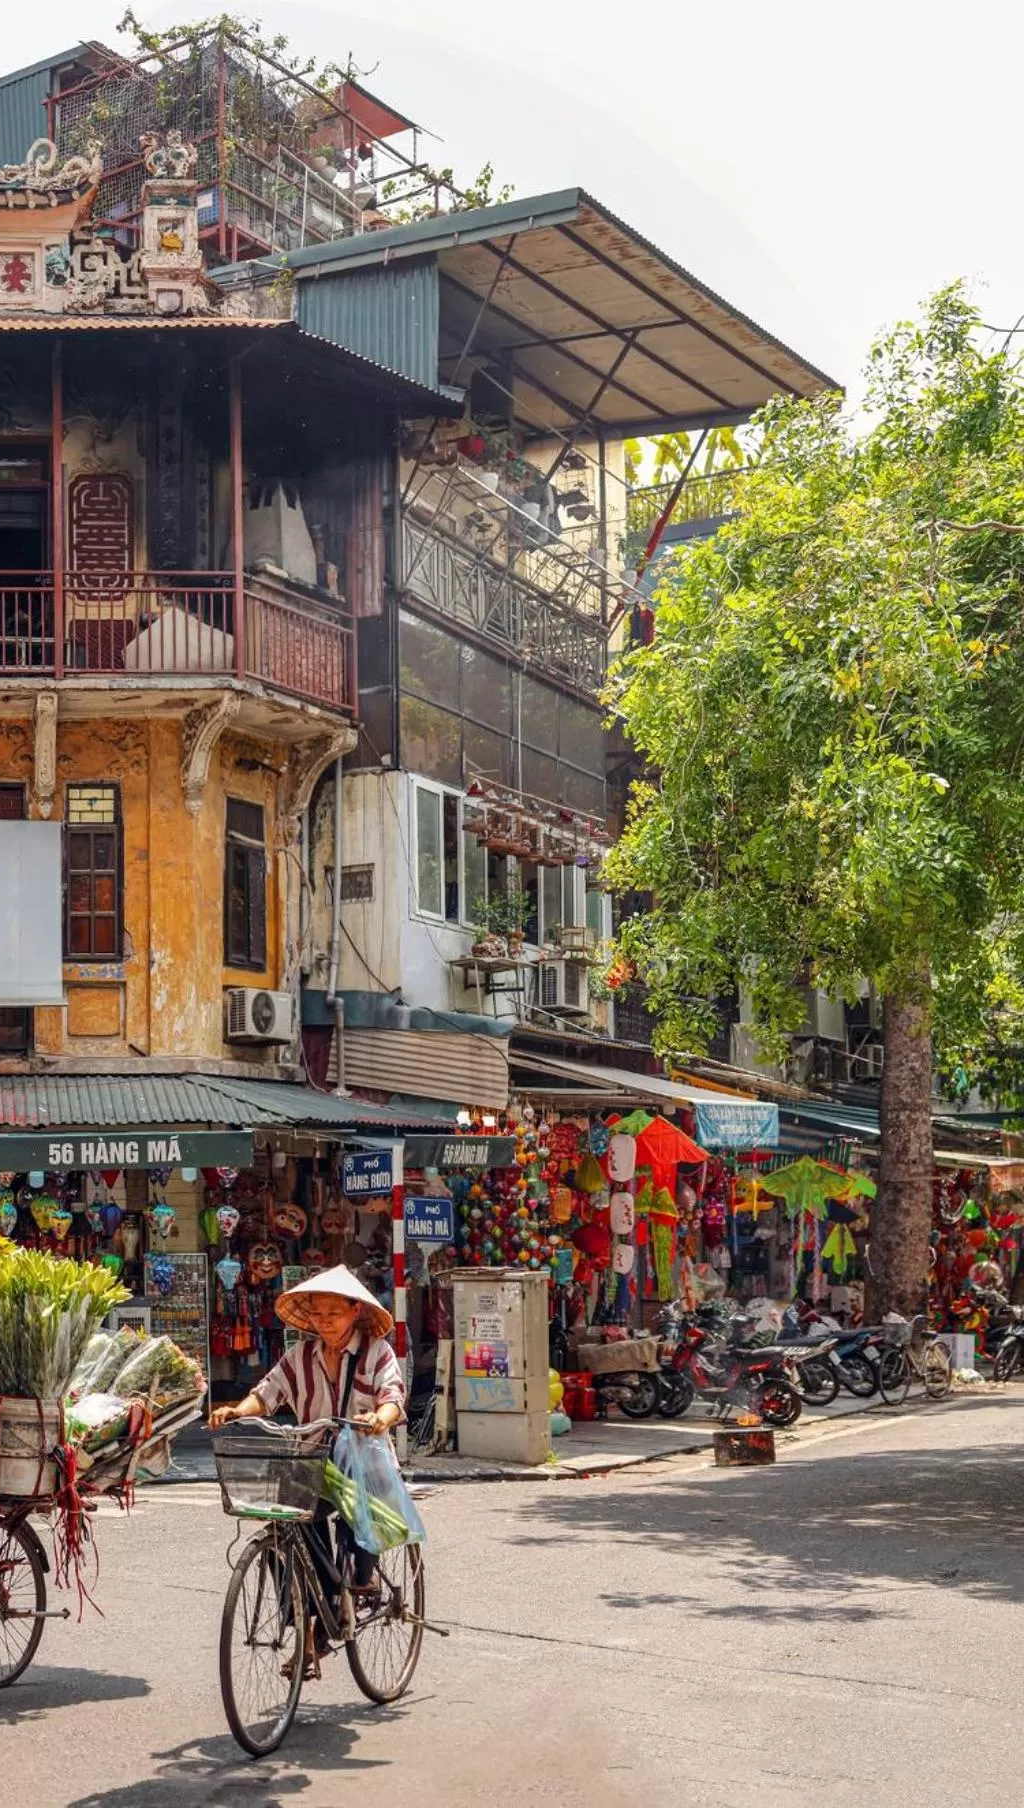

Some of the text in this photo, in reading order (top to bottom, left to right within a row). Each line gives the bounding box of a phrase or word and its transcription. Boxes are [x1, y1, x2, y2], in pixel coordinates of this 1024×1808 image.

[48, 1134, 183, 1164] 56 HÀNG MÃ
[442, 1144, 456, 1164] 56
[453, 1140, 476, 1164] HÀNG
[363, 1156, 379, 1170] PHỐ
[346, 1171, 391, 1191] HÀNG RƯƠI
[425, 1203, 440, 1215] PHỐ
[407, 1215, 449, 1236] HÀNG MÃ
